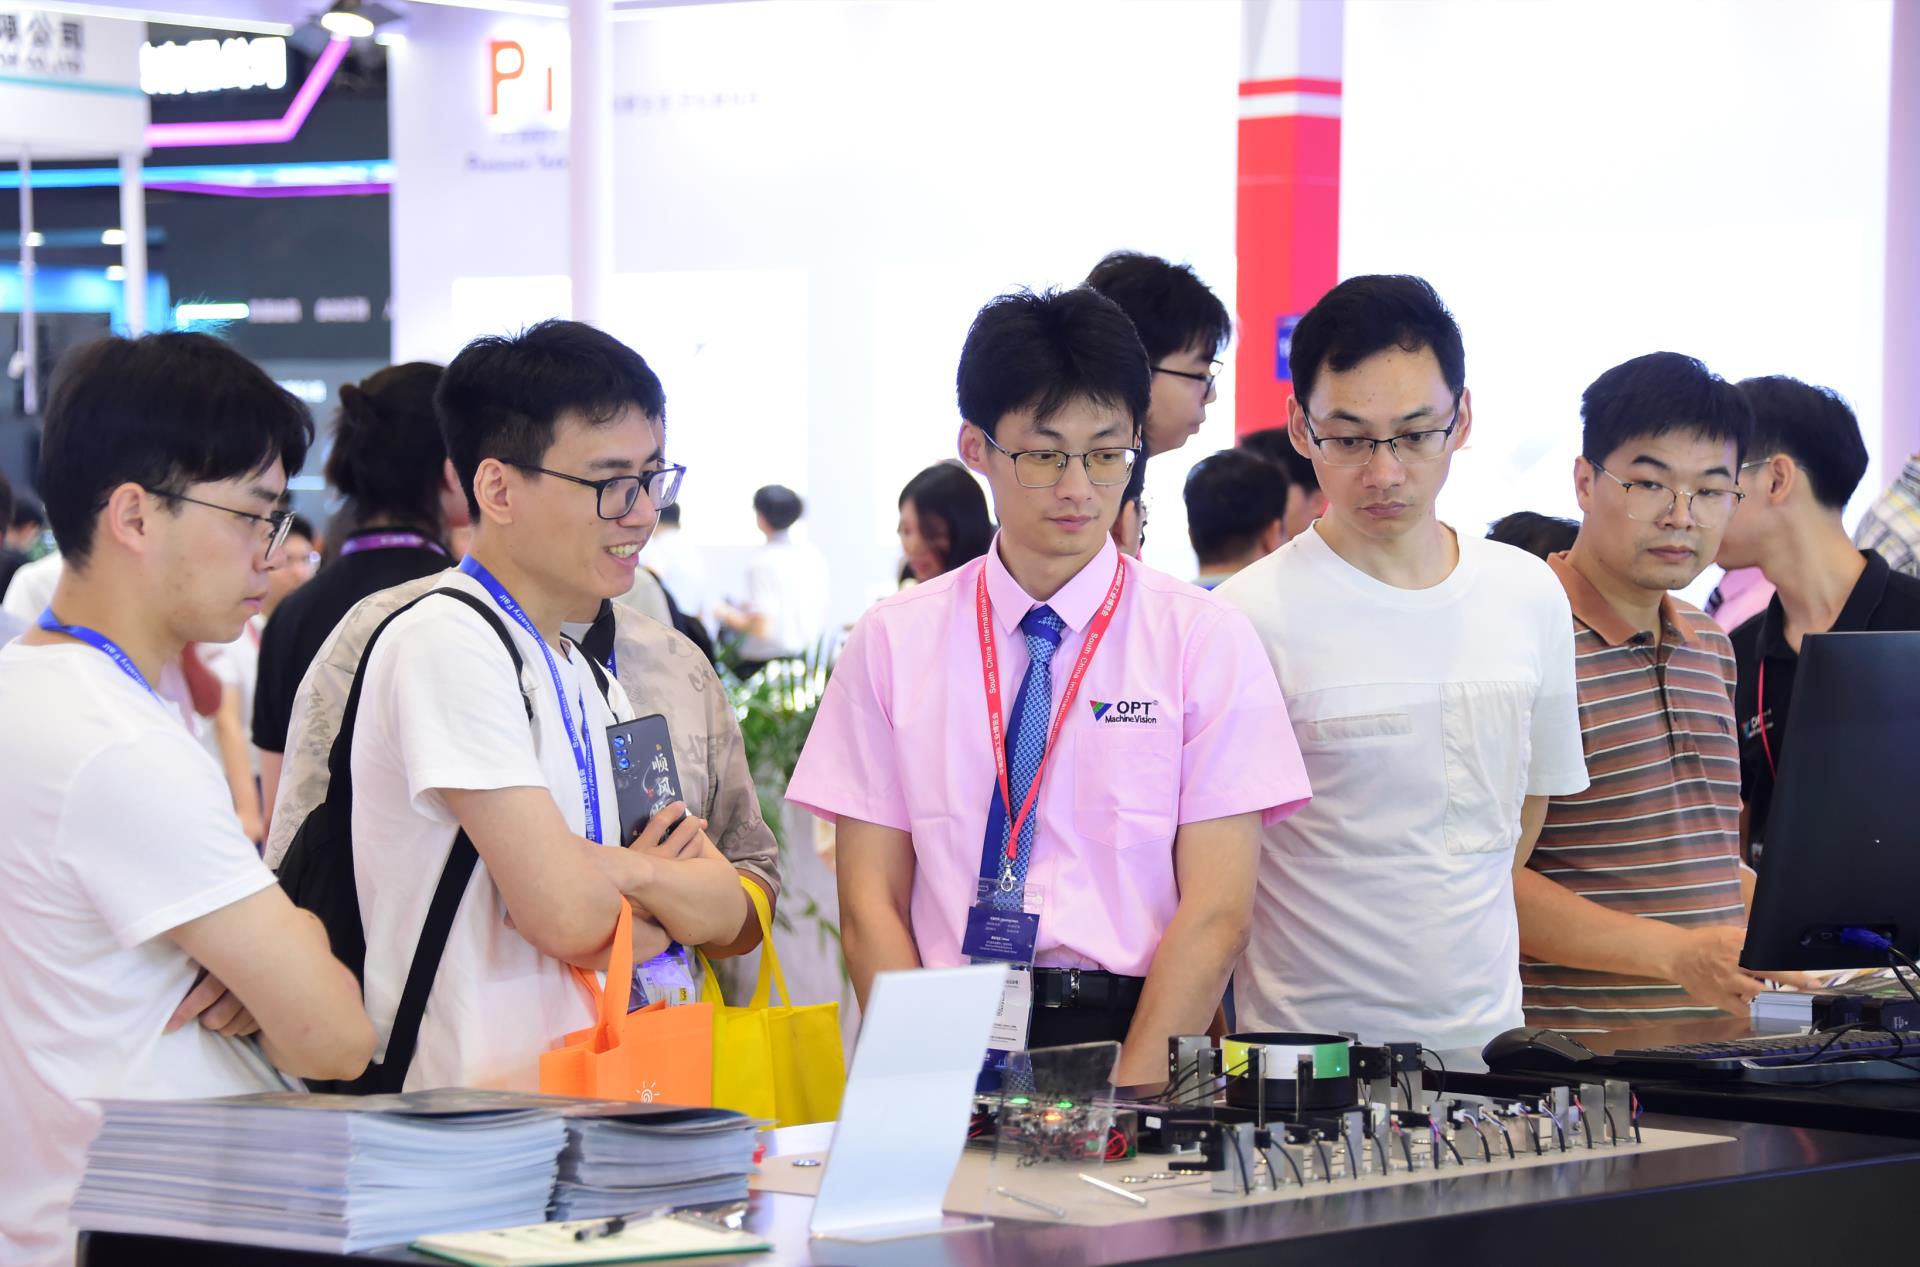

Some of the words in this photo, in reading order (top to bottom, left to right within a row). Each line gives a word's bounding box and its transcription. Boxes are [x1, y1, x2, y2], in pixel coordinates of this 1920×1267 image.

[499, 594, 515, 610] Fair
[513, 608, 539, 638] Industry
[981, 598, 991, 643] International
[1084, 632, 1099, 655] South
[986, 646, 994, 668] China
[1073, 657, 1088, 679] China
[989, 672, 997, 694] South
[1116, 701, 1152, 715] OPT
[569, 722, 580, 748] South
